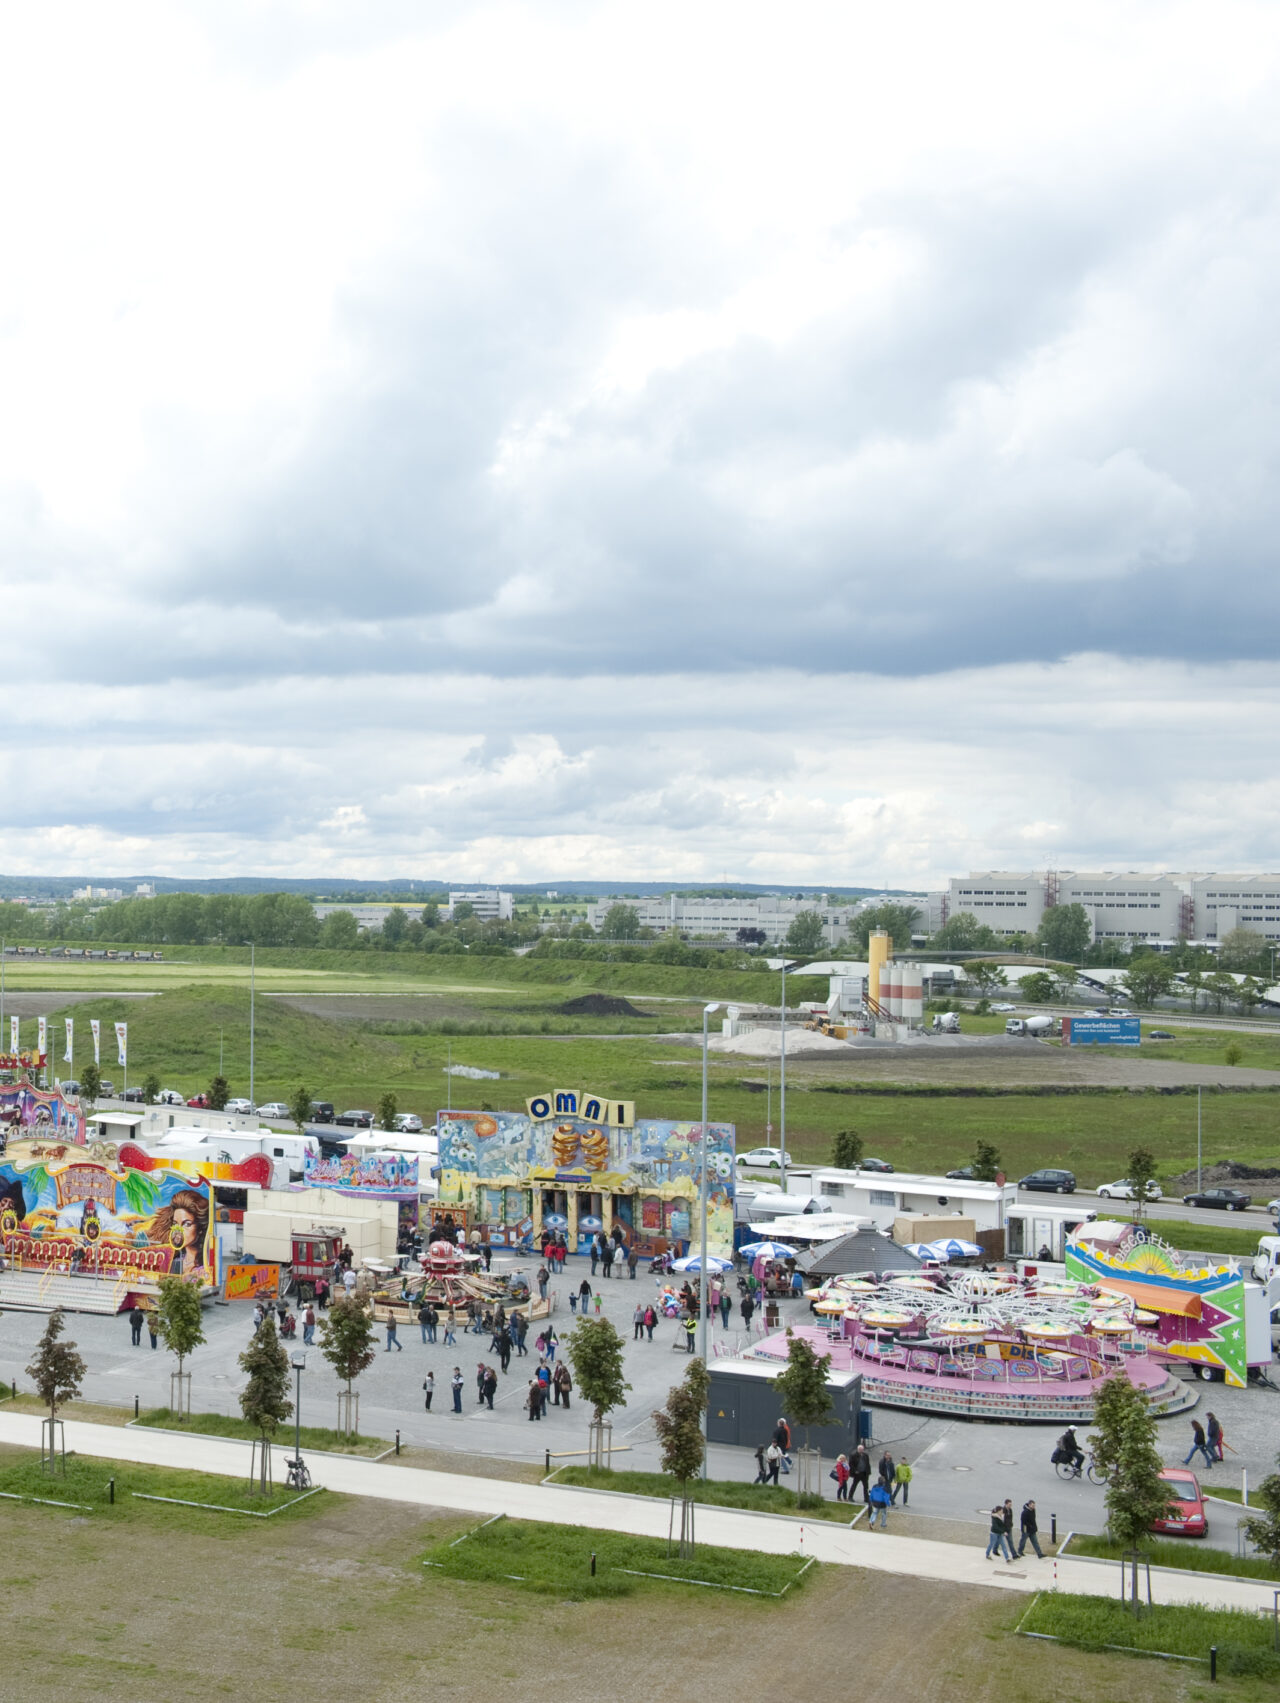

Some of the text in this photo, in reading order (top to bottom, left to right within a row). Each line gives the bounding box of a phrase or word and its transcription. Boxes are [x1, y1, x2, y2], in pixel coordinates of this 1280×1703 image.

[1115, 1231, 1186, 1275] DISCO FLYER
[229, 1275, 251, 1294] TOP
